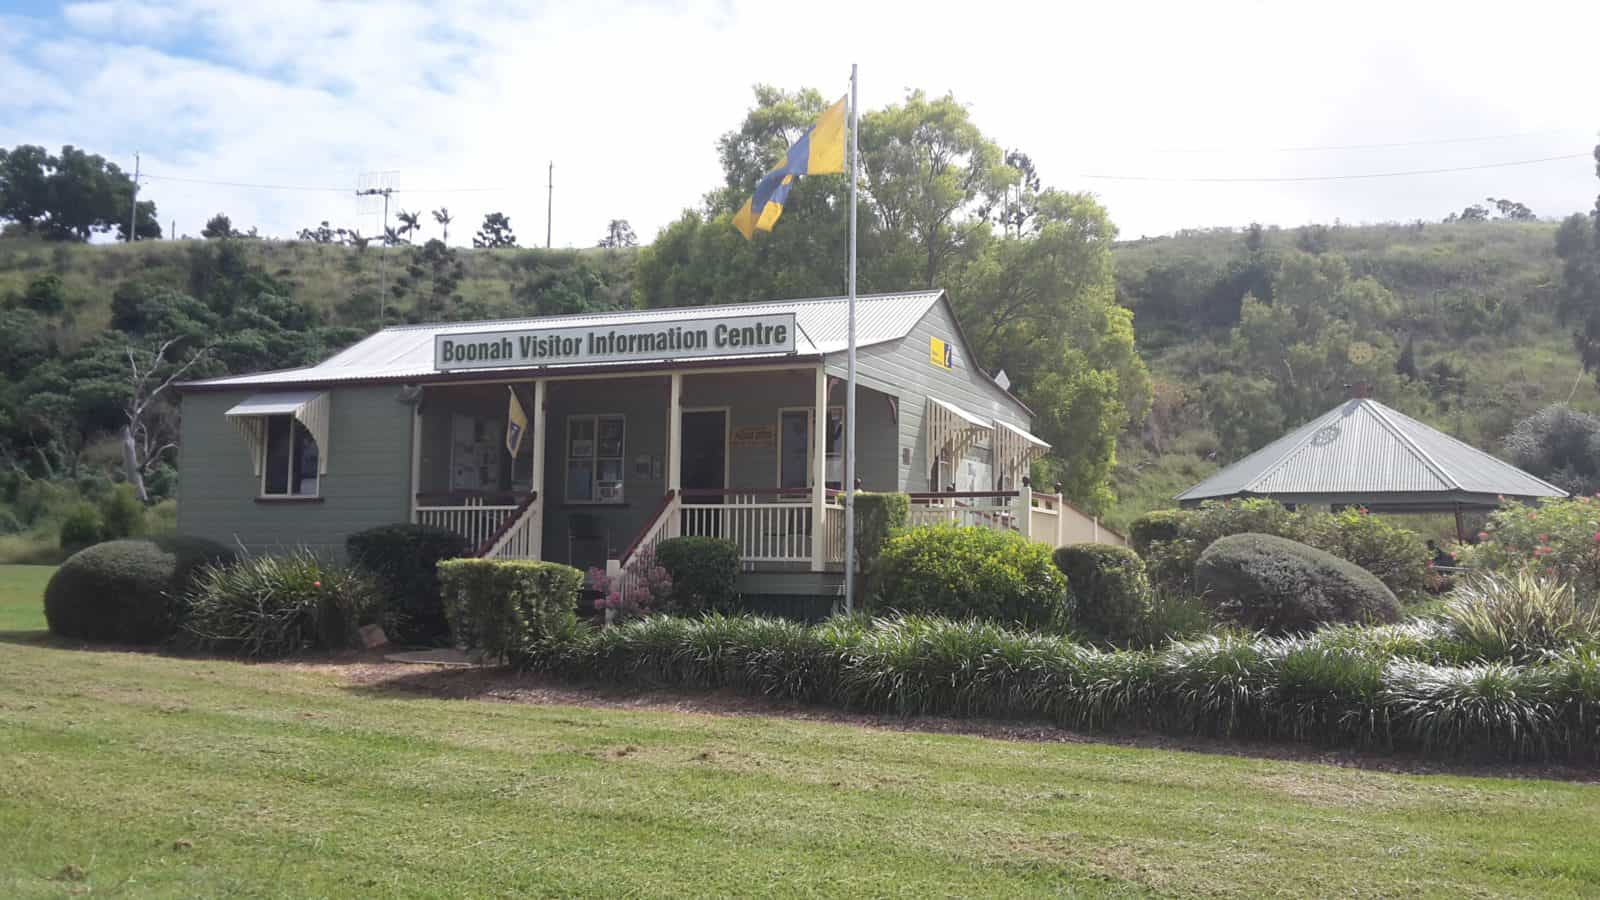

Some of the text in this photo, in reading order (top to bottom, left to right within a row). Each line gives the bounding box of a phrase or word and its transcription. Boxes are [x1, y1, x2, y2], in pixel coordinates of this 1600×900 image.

[443, 322, 787, 362] Boonah Visitor Information Centre
